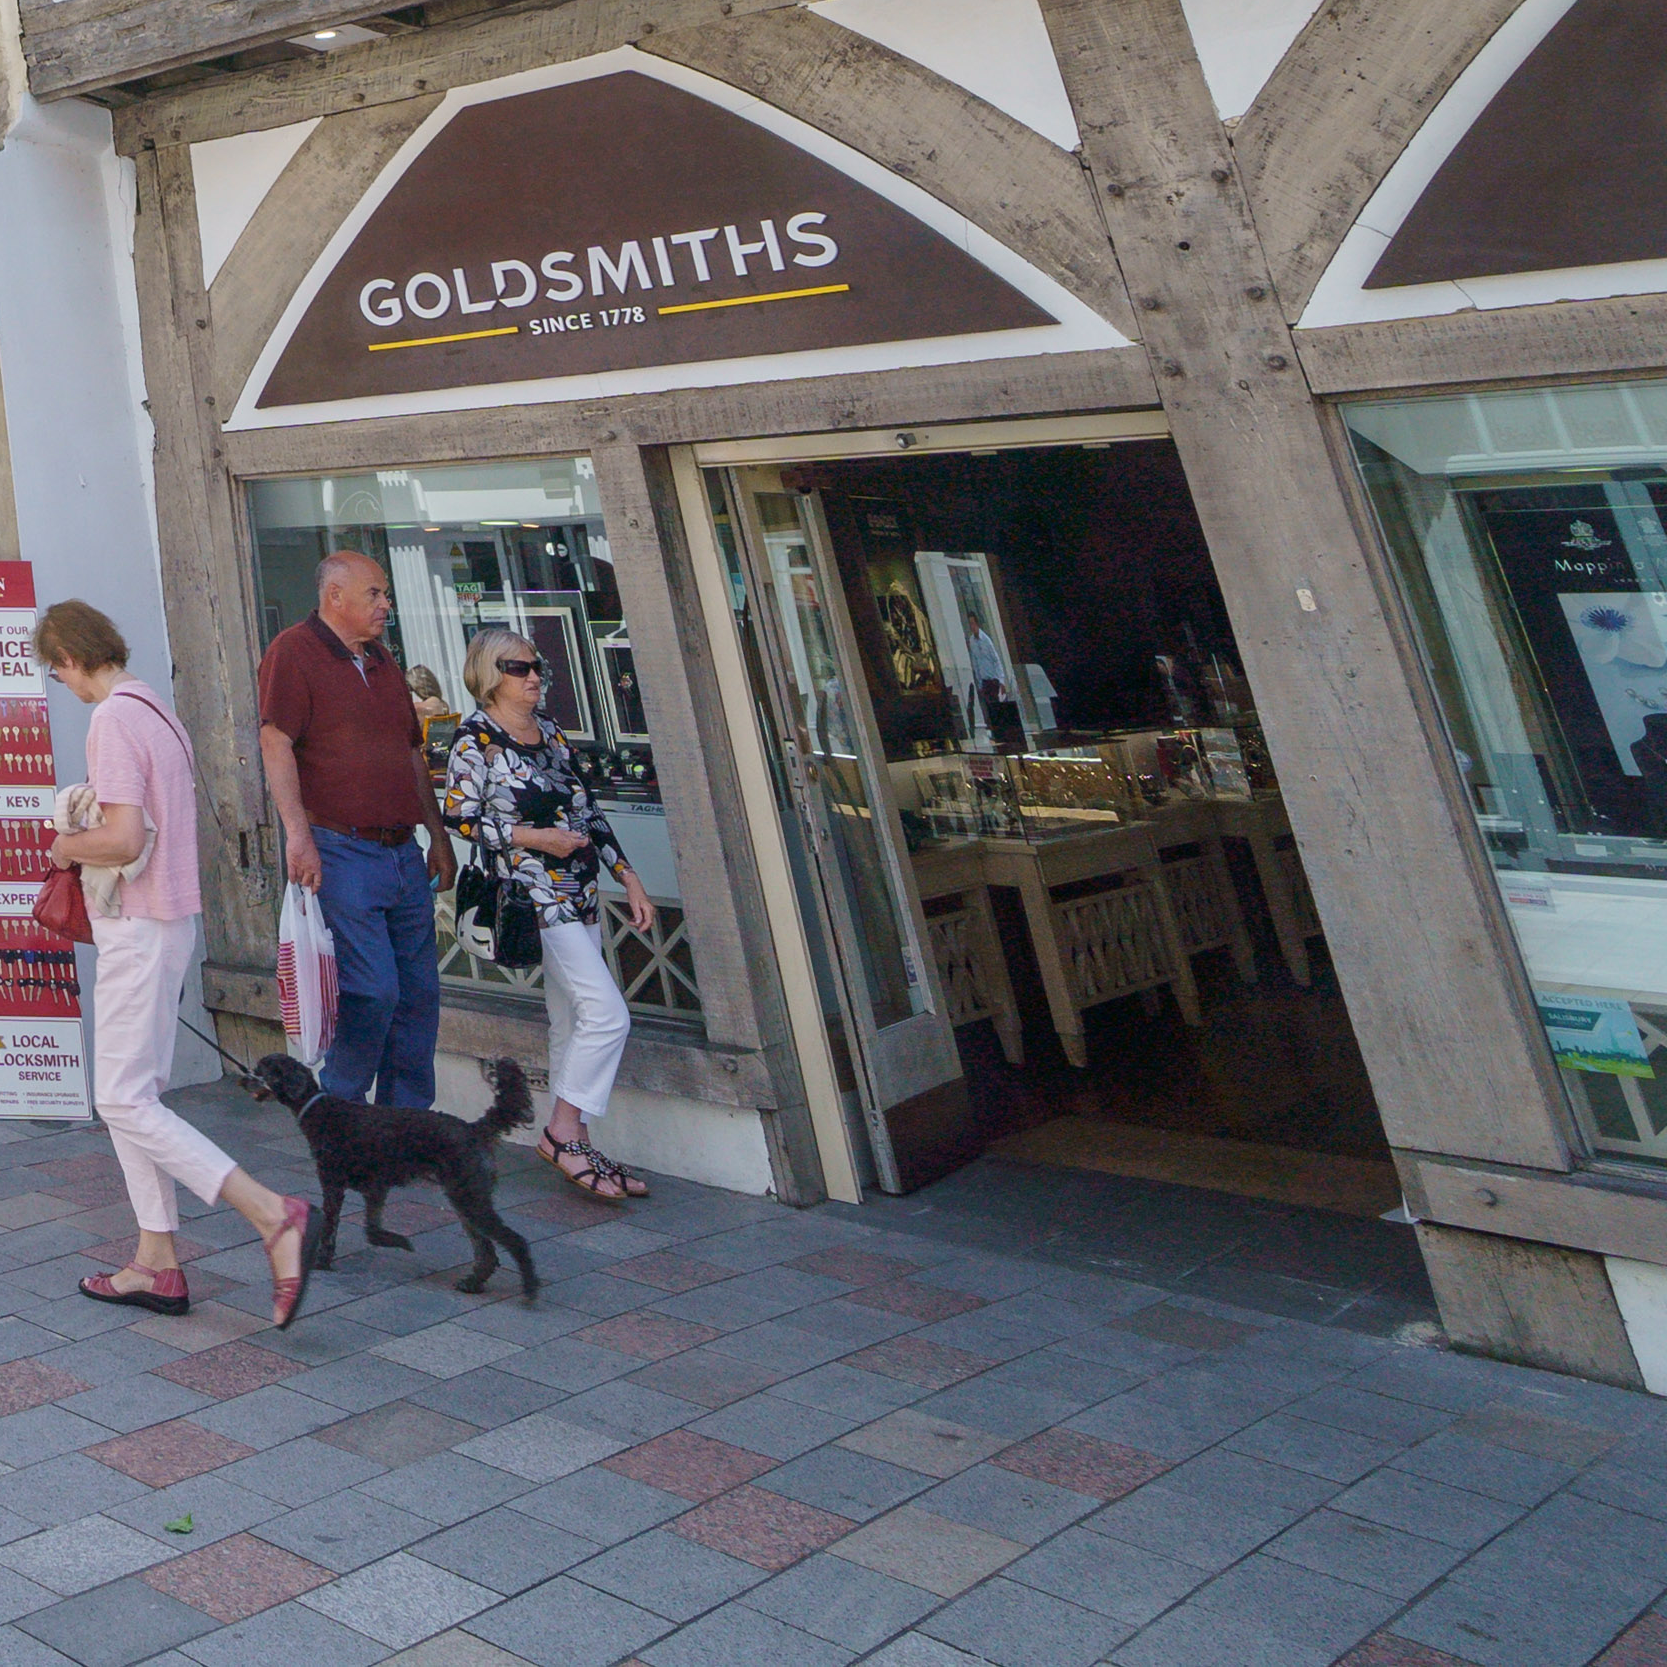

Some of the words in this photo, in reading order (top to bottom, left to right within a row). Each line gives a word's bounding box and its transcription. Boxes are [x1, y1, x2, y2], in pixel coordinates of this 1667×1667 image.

[359, 211, 839, 327] GOLDSMITHS
[529, 313, 594, 335] SINCE
[599, 306, 646, 327] 1778
[7, 626, 29, 635] OUR
[6, 796, 40, 808] KEYS
[1542, 996, 1592, 1007] ACCEPTED
[1595, 999, 1622, 1011] HERE
[1547, 1012, 1591, 1024] SALISBURY
[12, 1035, 59, 1049] LOCAL
[19, 1071, 62, 1082] SERVICE
